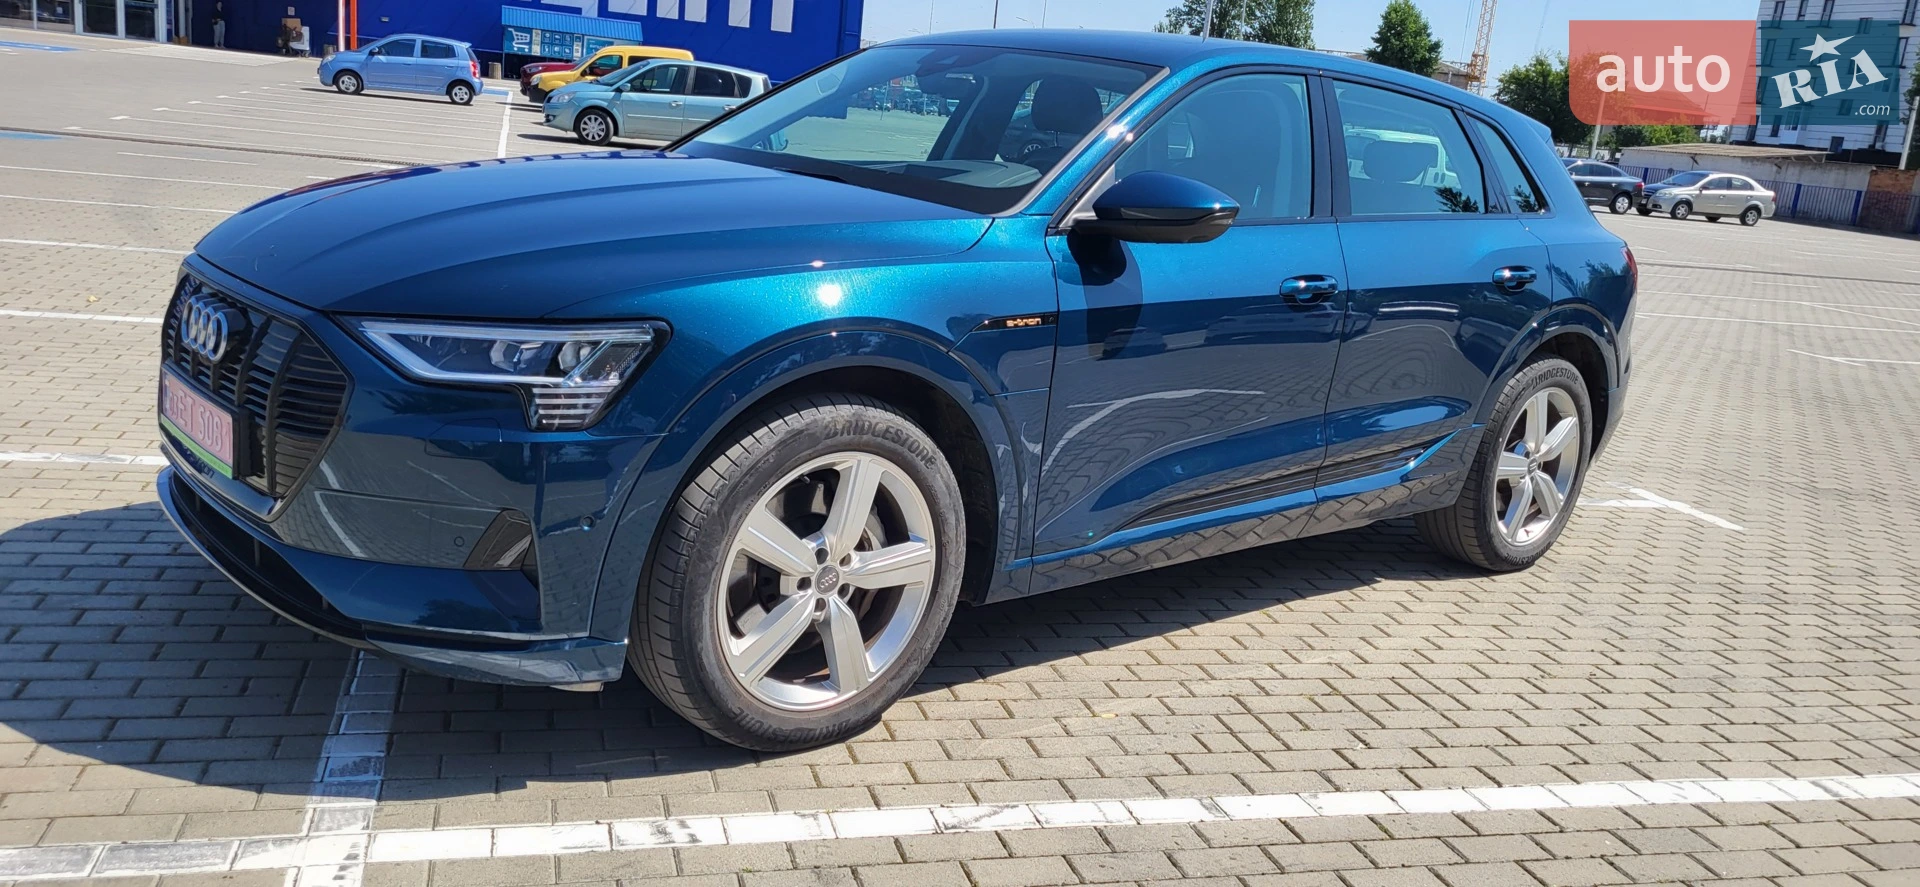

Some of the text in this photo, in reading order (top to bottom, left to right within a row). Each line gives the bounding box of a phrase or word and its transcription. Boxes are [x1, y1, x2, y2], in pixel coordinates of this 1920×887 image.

[1006, 317, 1042, 327] e-tron
[1531, 367, 1579, 391] BRIDGESTONE
[199, 404, 231, 461] 5081
[823, 419, 937, 470] BRIDGESTONE
